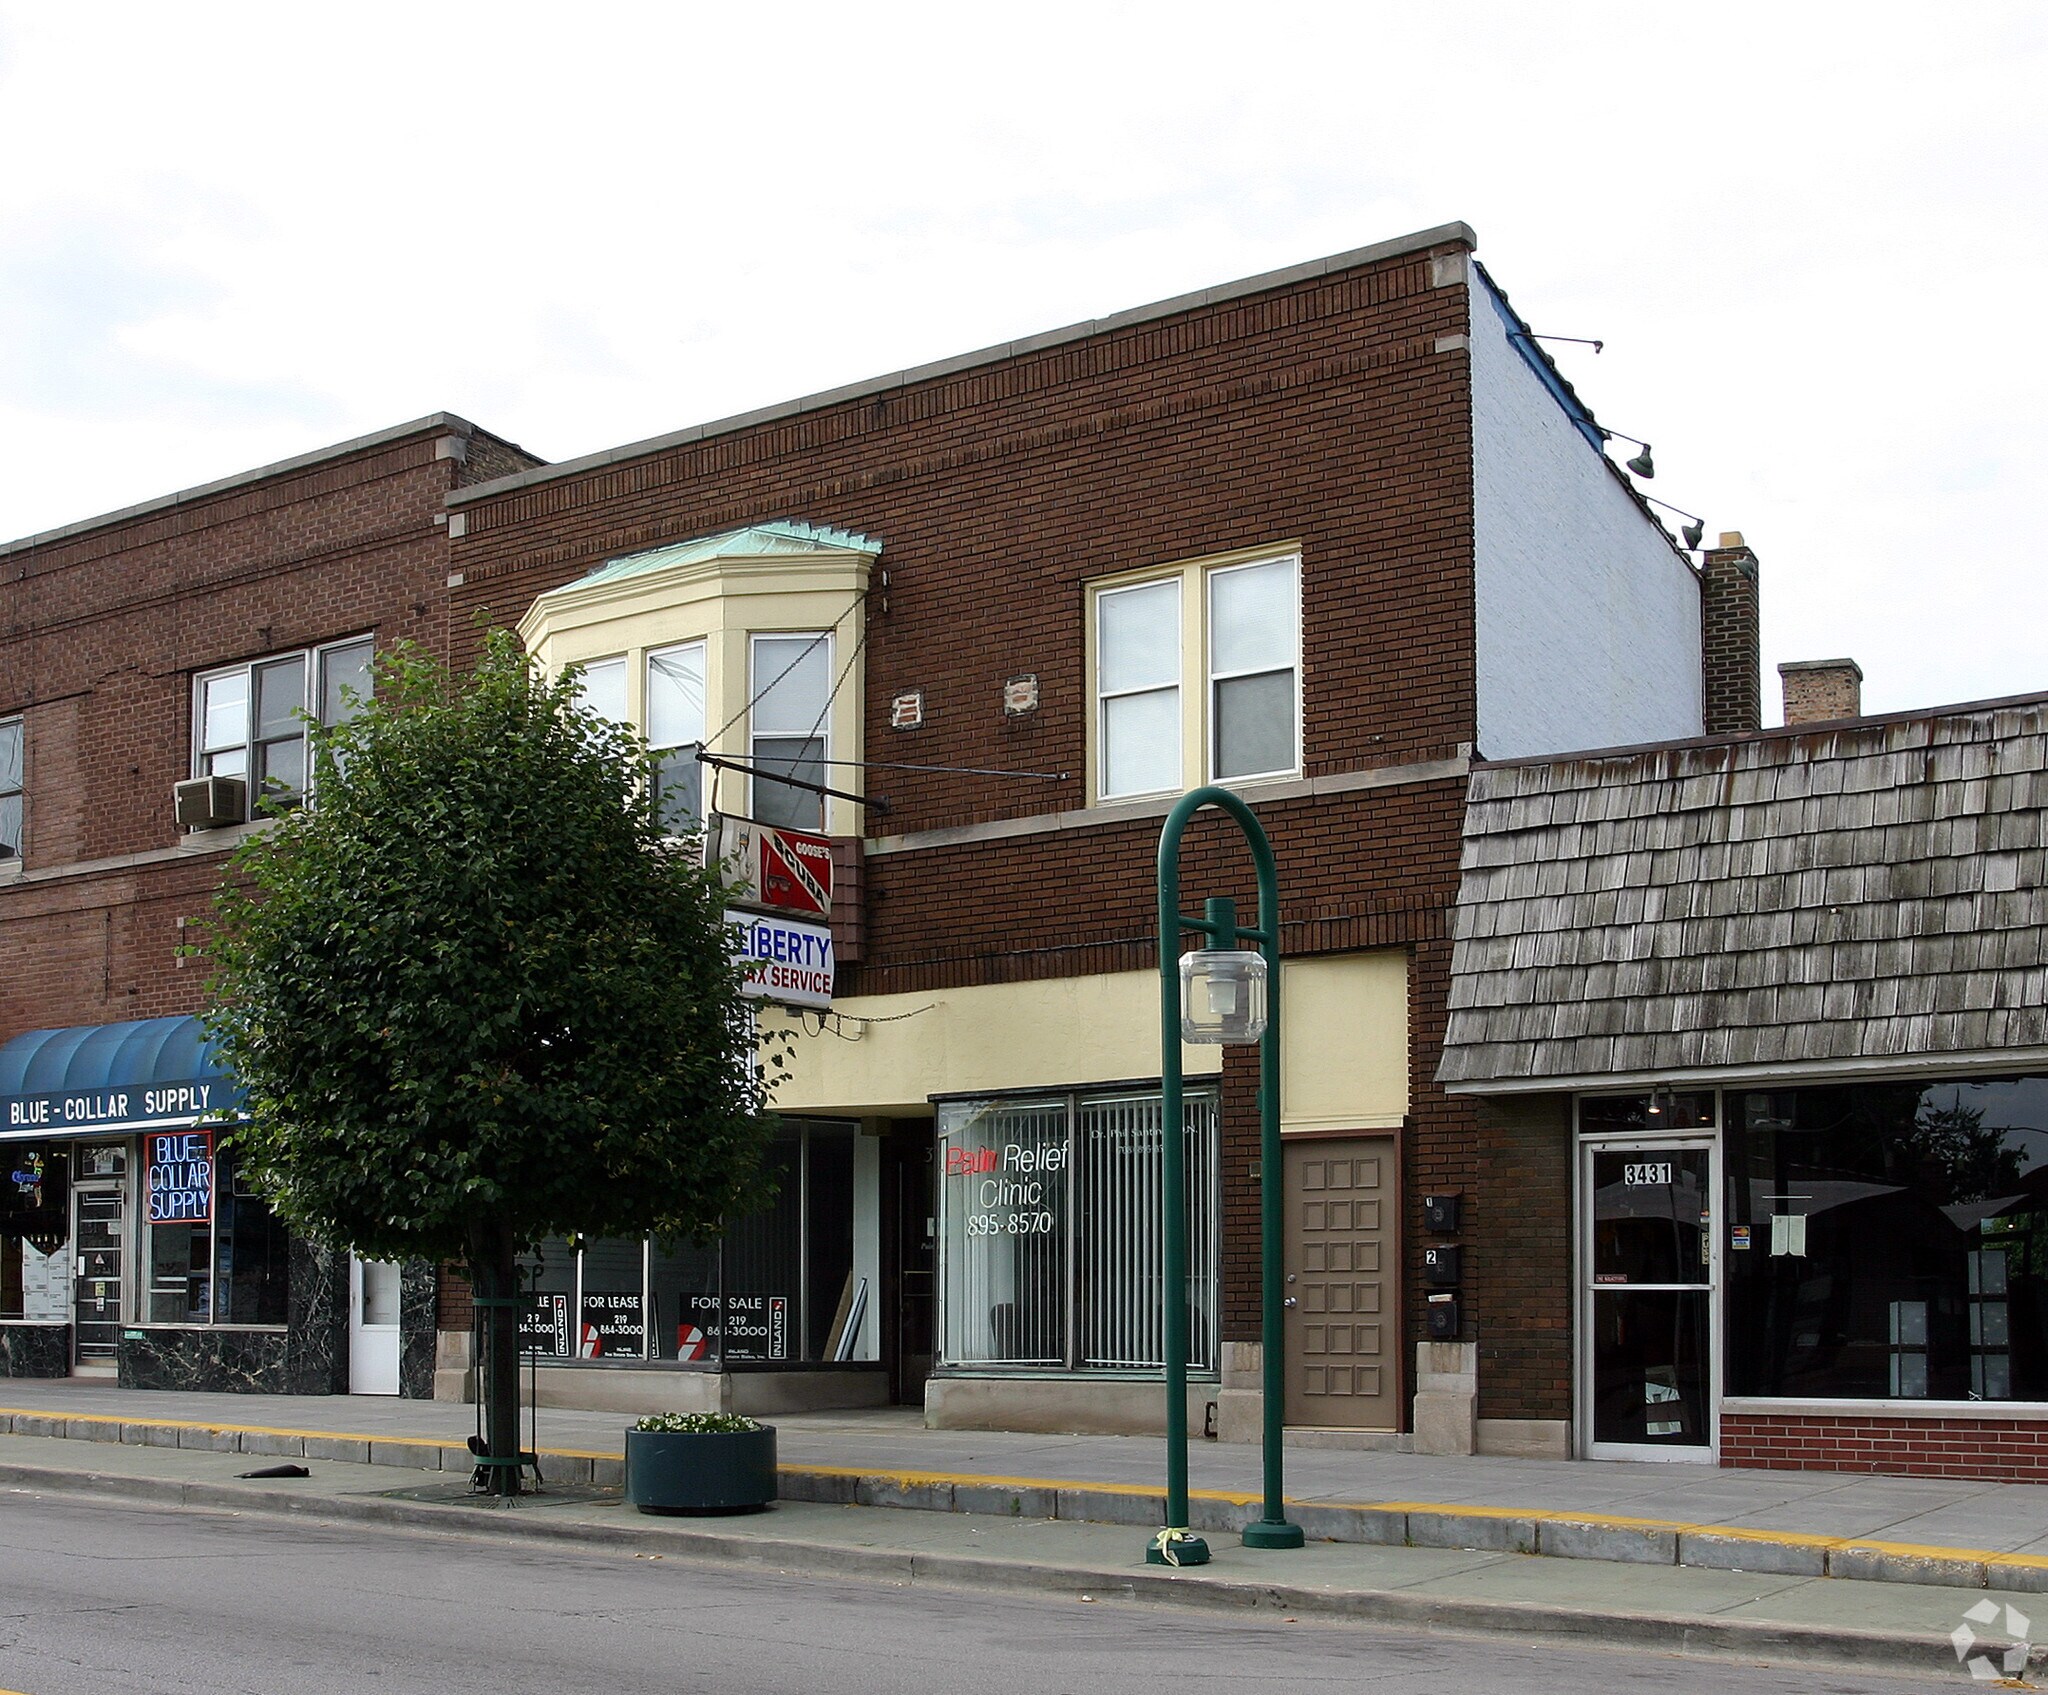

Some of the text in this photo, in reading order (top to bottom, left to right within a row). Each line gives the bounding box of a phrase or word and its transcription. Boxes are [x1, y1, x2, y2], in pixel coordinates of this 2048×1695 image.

[795, 841, 830, 860] GOOSE'S
[774, 834, 825, 908] SCUBA
[771, 966, 831, 994] SERVICE
[144, 1084, 211, 1114] SUPPLY
[156, 1135, 207, 1163] BLUE-
[946, 1139, 1070, 1176] Pain Relief
[149, 1162, 211, 1191] COLLAR
[1626, 1164, 1669, 1184] 3431
[149, 1190, 210, 1219] SUPPLY
[980, 1176, 1042, 1208] Clinic
[967, 1212, 1052, 1236] 895-8570
[1427, 1251, 1435, 1264] 2
[583, 1296, 639, 1308] FOR LEASE
[691, 1297, 762, 1309] FOR SALE
[527, 1314, 540, 1323] 29
[557, 1309, 565, 1353] INLAND
[600, 1325, 643, 1335] 864-3000
[614, 1315, 627, 1324] 219
[728, 1316, 747, 1325] 219
[773, 1311, 782, 1357] INLAND
